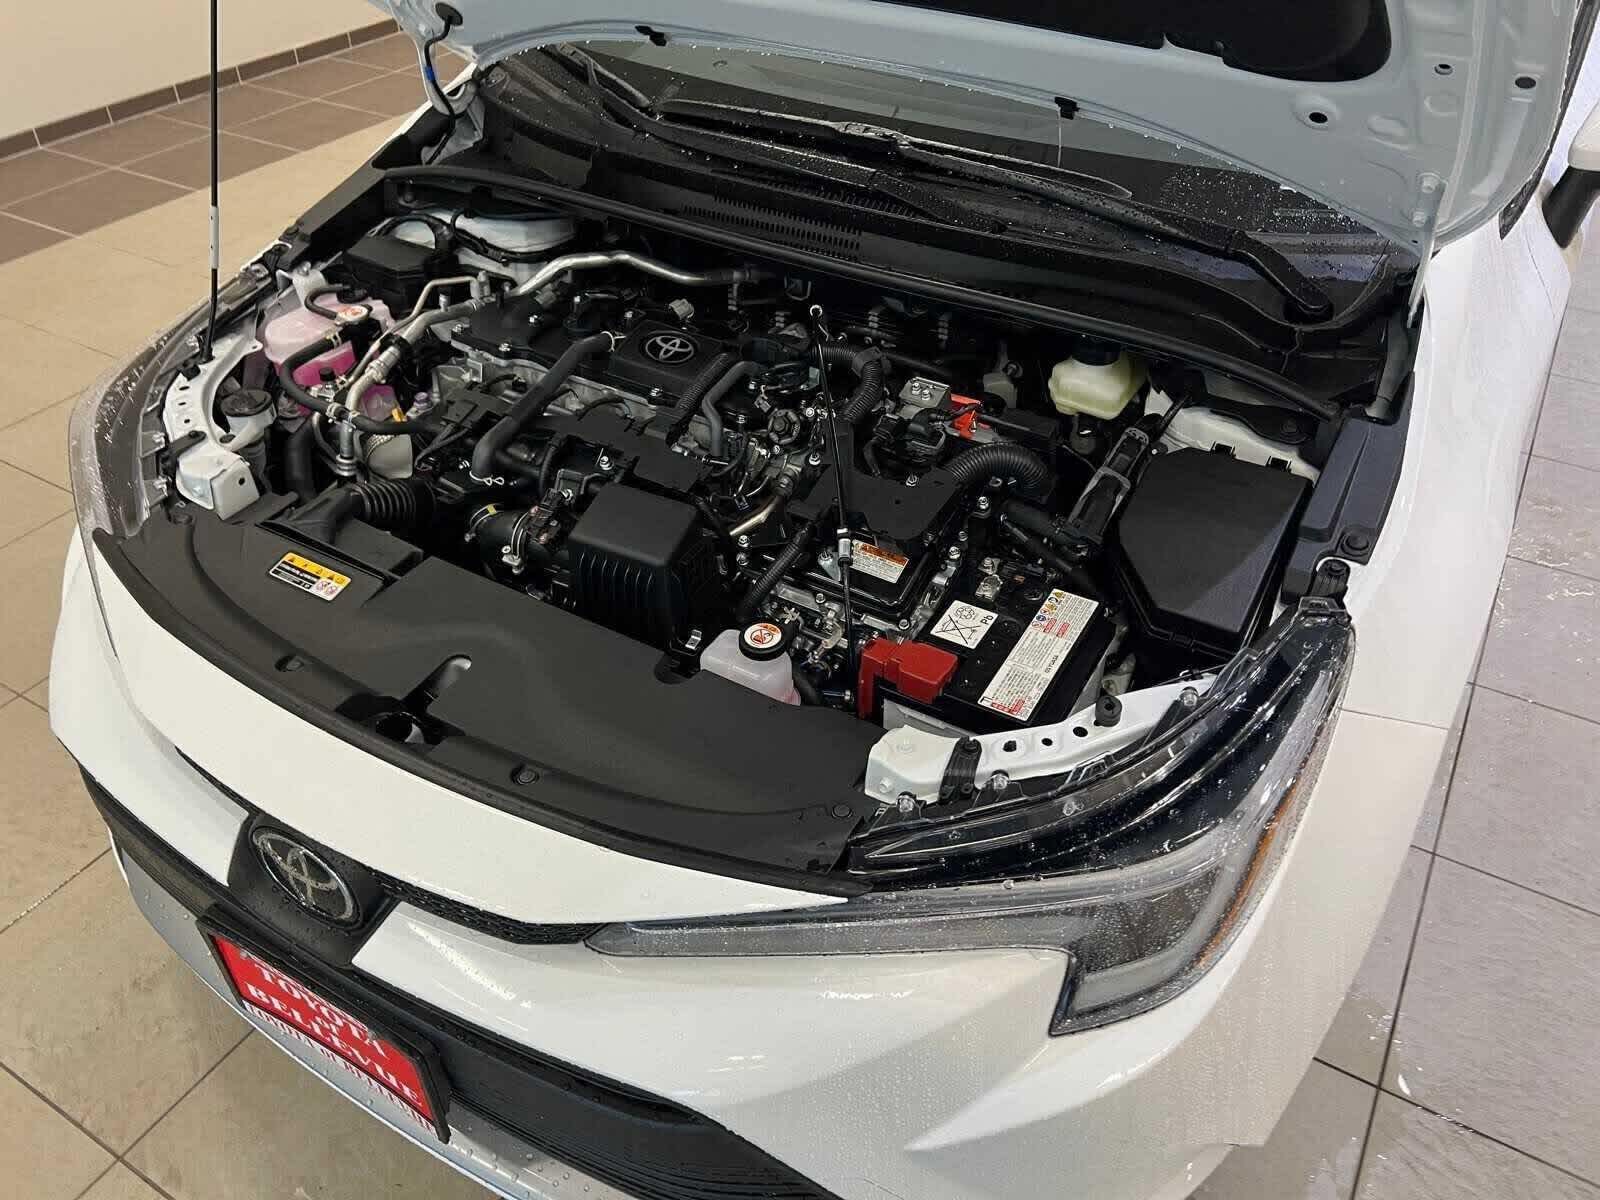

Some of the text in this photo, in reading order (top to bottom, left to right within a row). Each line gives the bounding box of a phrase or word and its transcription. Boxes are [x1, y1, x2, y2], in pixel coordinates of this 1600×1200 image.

[980, 615, 994, 625] Pb
[246, 983, 423, 1107] BELLEVUE
[255, 962, 388, 1058] TOYOTA
